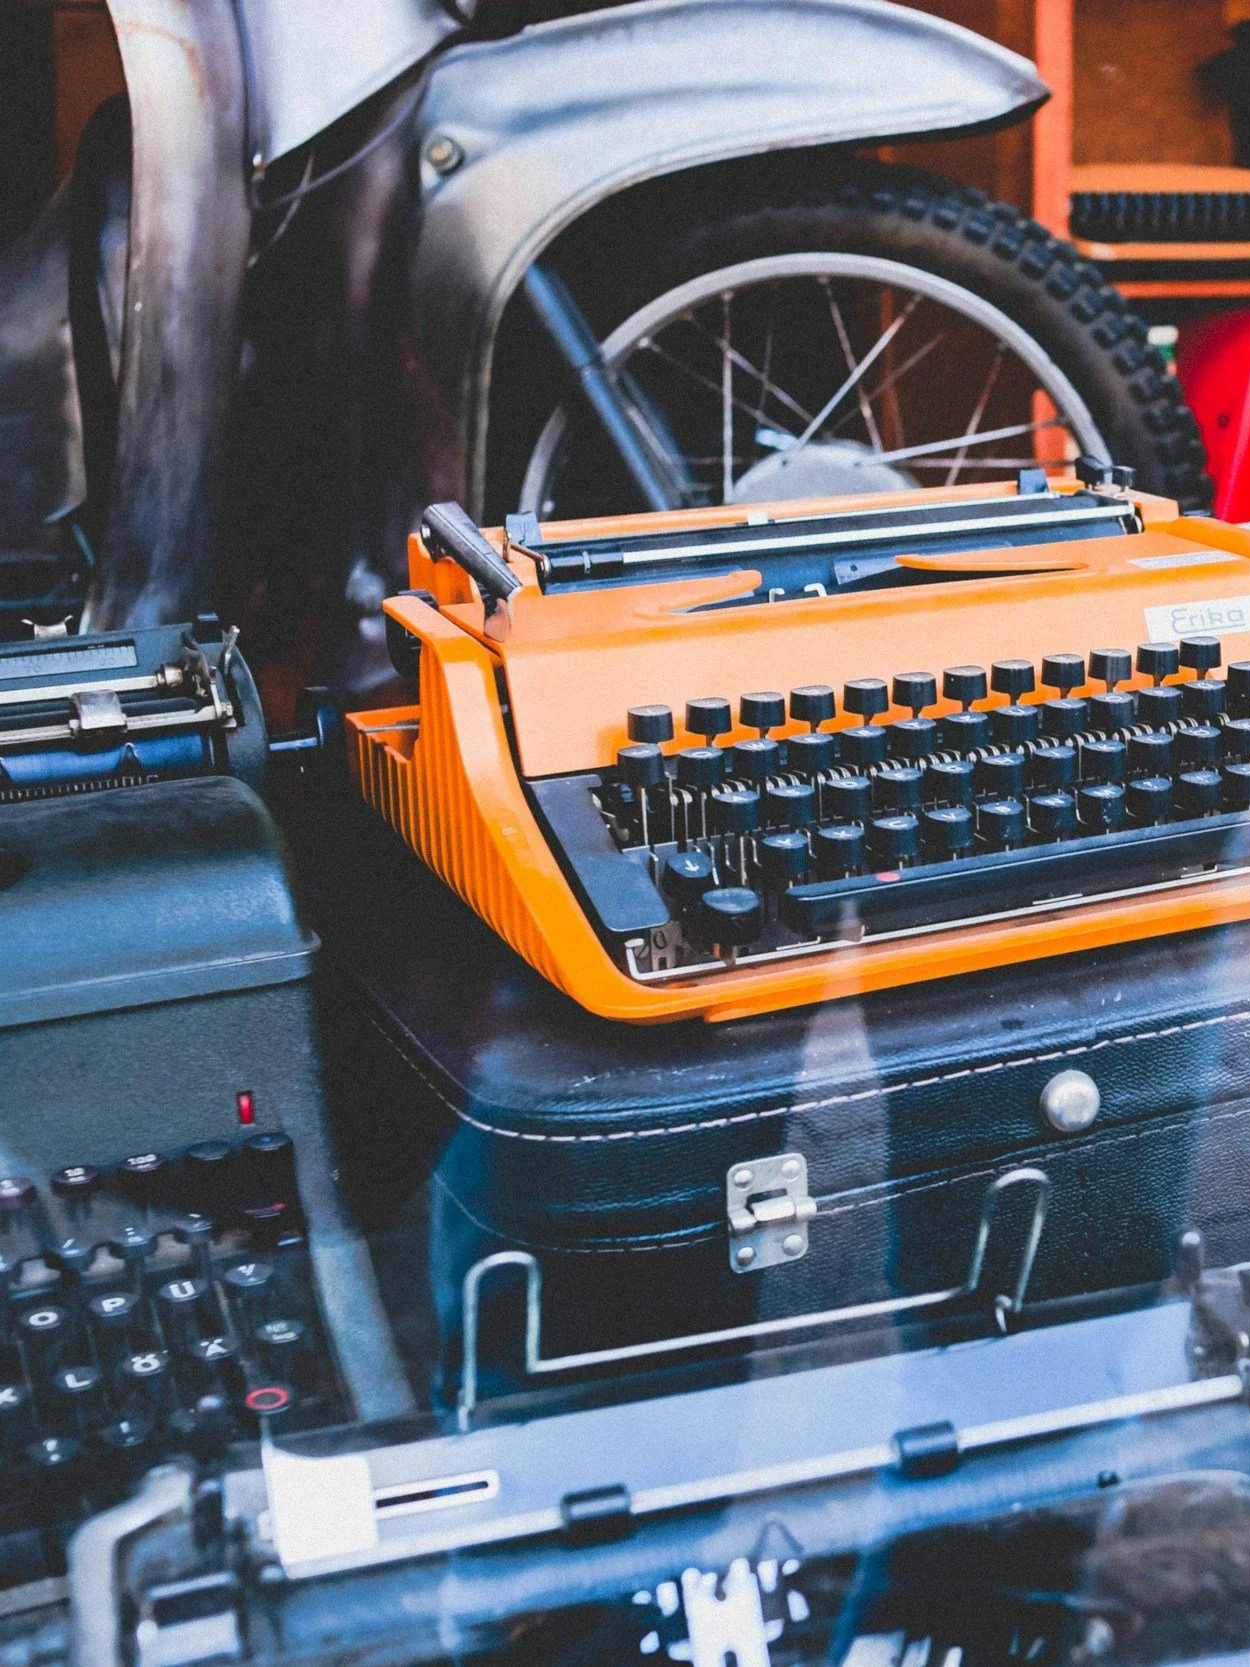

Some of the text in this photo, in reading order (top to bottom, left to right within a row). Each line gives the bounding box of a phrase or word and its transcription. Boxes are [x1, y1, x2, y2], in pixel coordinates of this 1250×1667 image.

[1171, 607, 1246, 634] Erika
[833, 830, 852, 838] X
[888, 820, 908, 828] C
[941, 812, 957, 820] V
[29, 1311, 58, 1326] O
[101, 1297, 126, 1312] P
[64, 1373, 92, 1388] L
[131, 1354, 160, 1373] Ö
[200, 1339, 227, 1356] Ä
